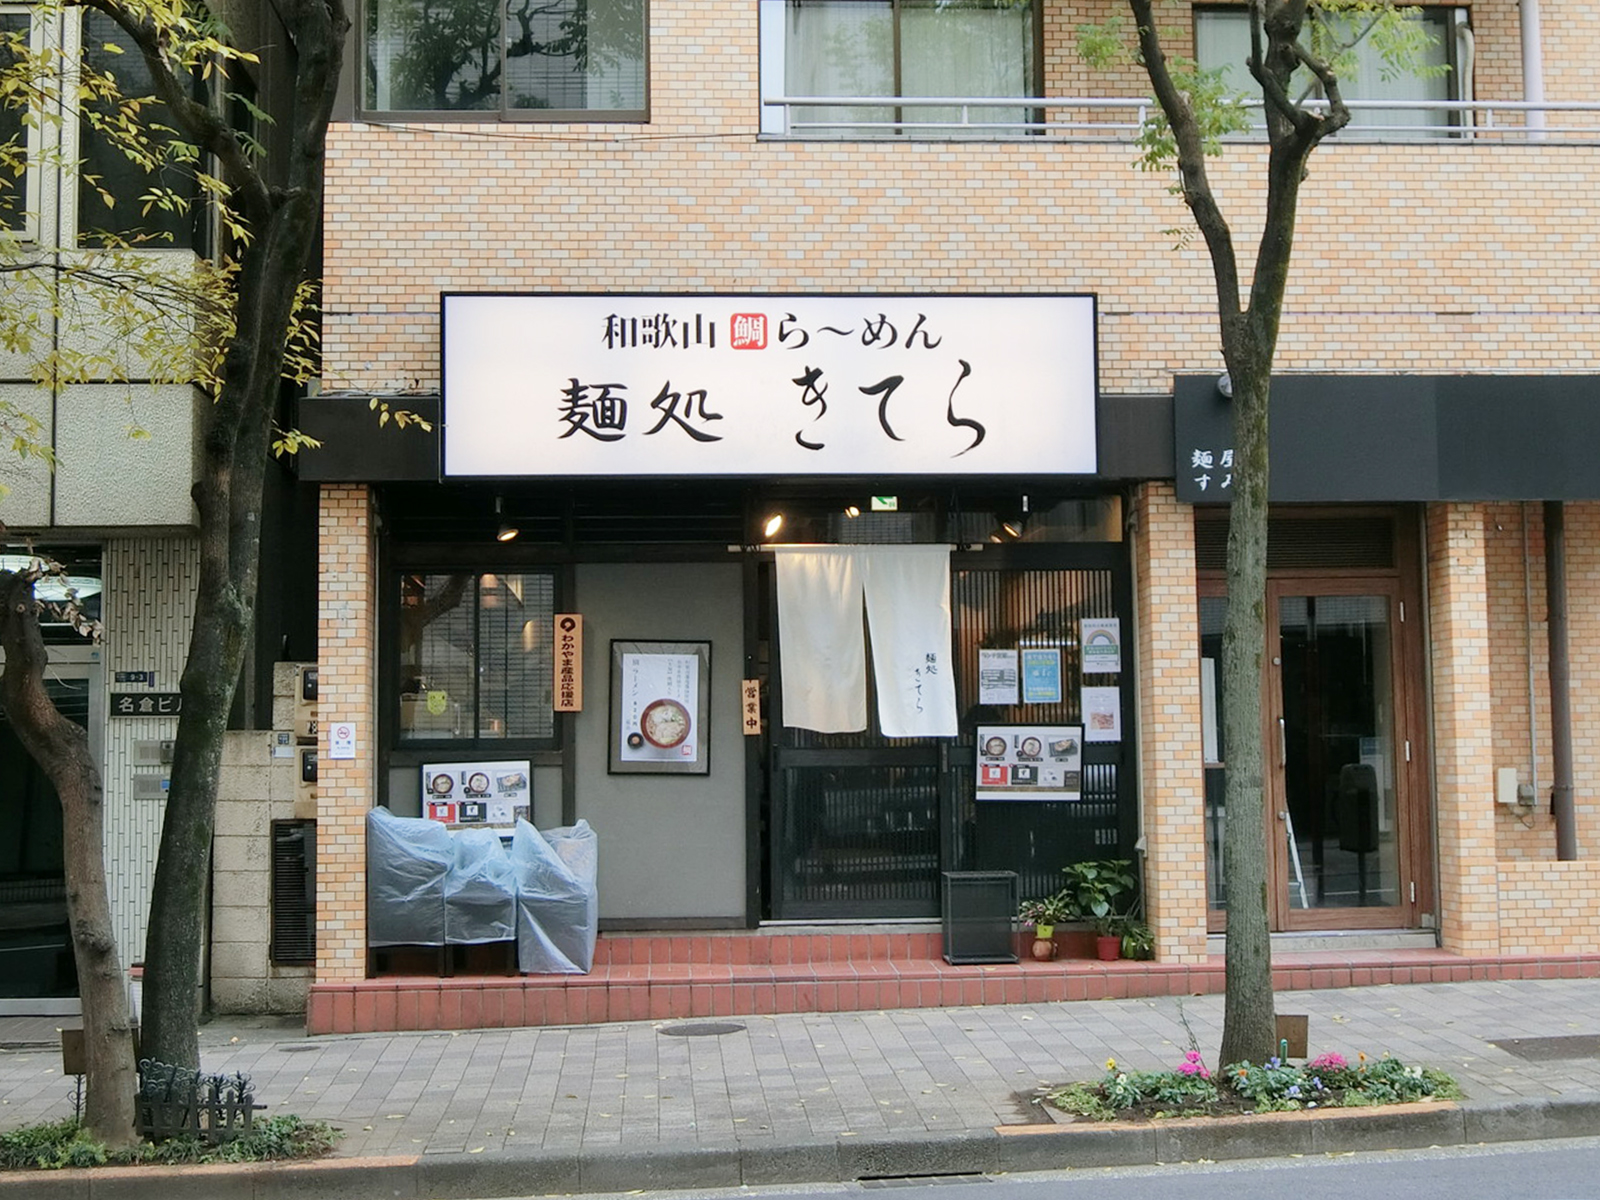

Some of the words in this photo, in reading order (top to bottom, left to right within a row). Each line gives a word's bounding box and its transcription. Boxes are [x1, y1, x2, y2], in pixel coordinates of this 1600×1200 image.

[603, 313, 716, 350] 和歌山
[731, 312, 766, 349] 鯛
[558, 378, 724, 443] 麺処
[792, 359, 986, 457] きてら
[560, 634, 575, 708] わかやま産品応援店
[925, 652, 938, 675] 麺処
[744, 686, 758, 730] 営業中
[914, 668, 924, 714] きてら
